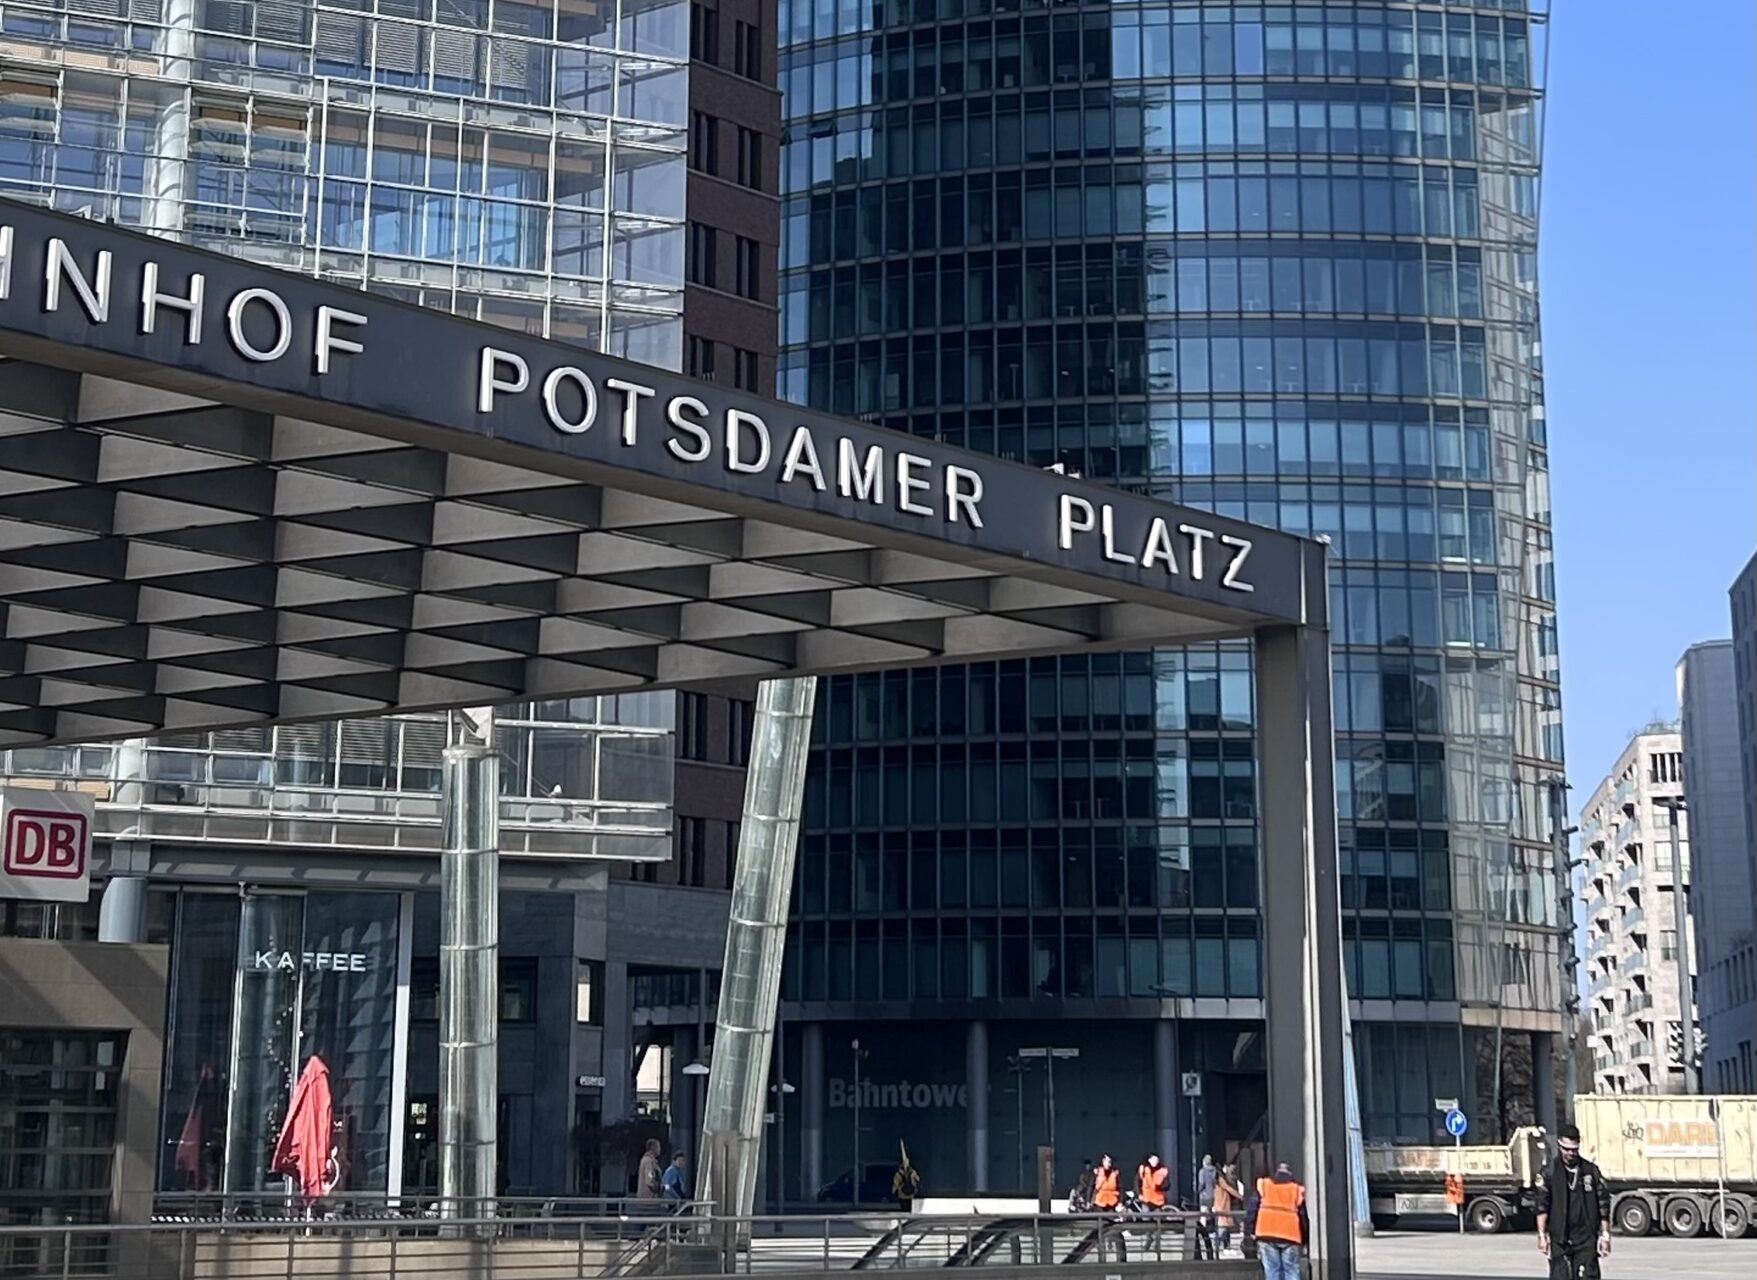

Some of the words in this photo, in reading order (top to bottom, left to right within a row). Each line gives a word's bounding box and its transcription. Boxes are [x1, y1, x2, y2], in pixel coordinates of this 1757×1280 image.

[0, 225, 368, 375] NHOF
[477, 345, 984, 528] POTSDAMER
[1058, 493, 1254, 593] PLATZ
[15, 819, 77, 868] DB
[828, 1076, 992, 1109] Bahntowe
